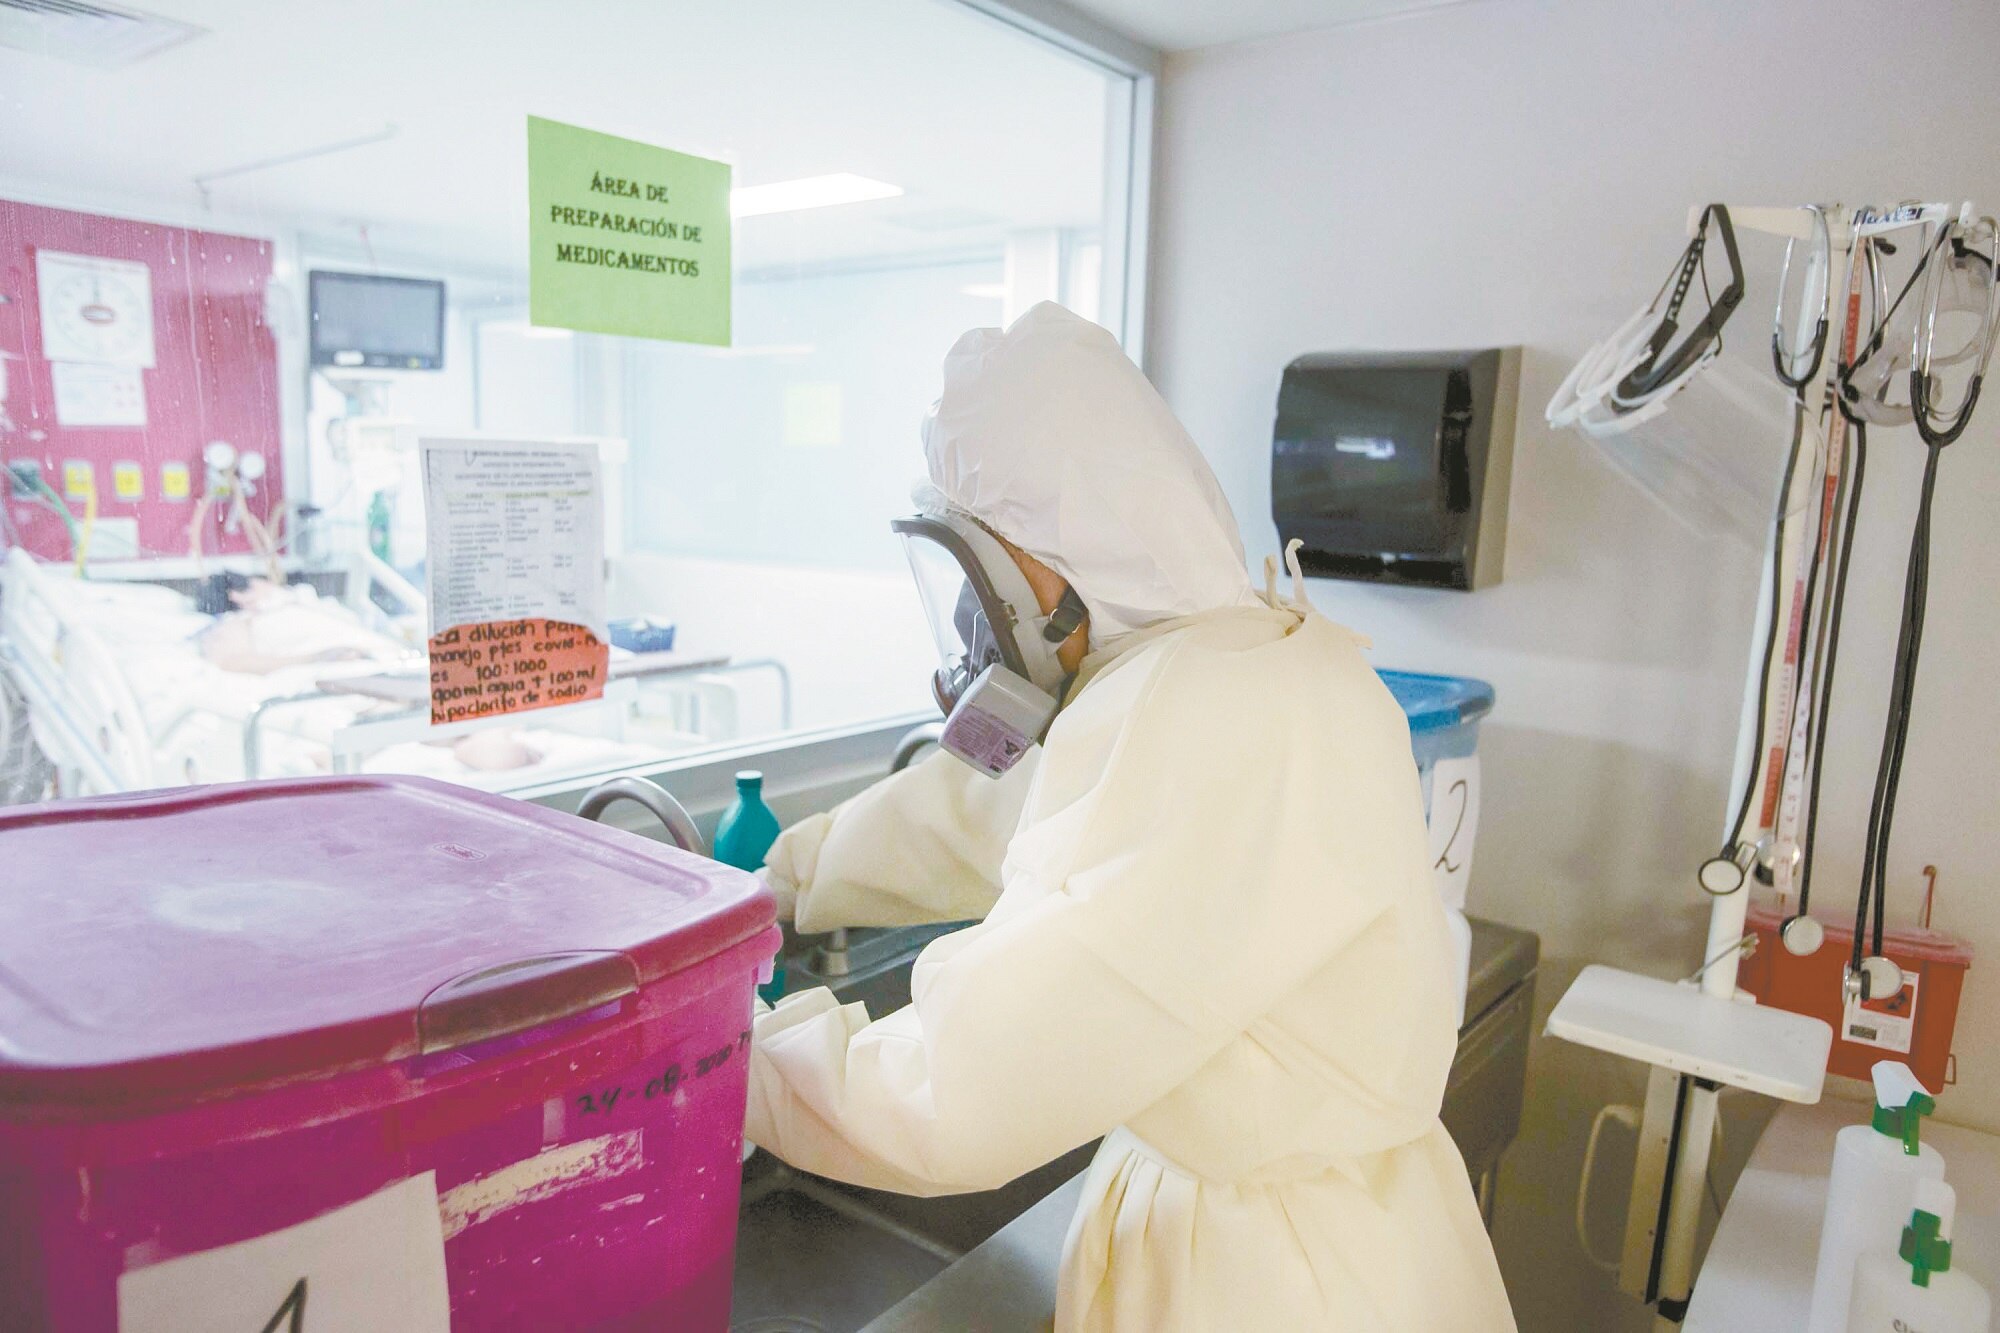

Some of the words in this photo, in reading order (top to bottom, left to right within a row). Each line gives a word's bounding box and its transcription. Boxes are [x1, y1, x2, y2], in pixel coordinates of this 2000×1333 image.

[590, 171, 641, 199] ÁREA
[646, 184, 669, 204] DE
[550, 204, 678, 240] PREPARACIÓN
[682, 224, 703, 243] DE
[556, 243, 700, 278] MEDICAMENTOS
[1434, 778, 1468, 874] 2
